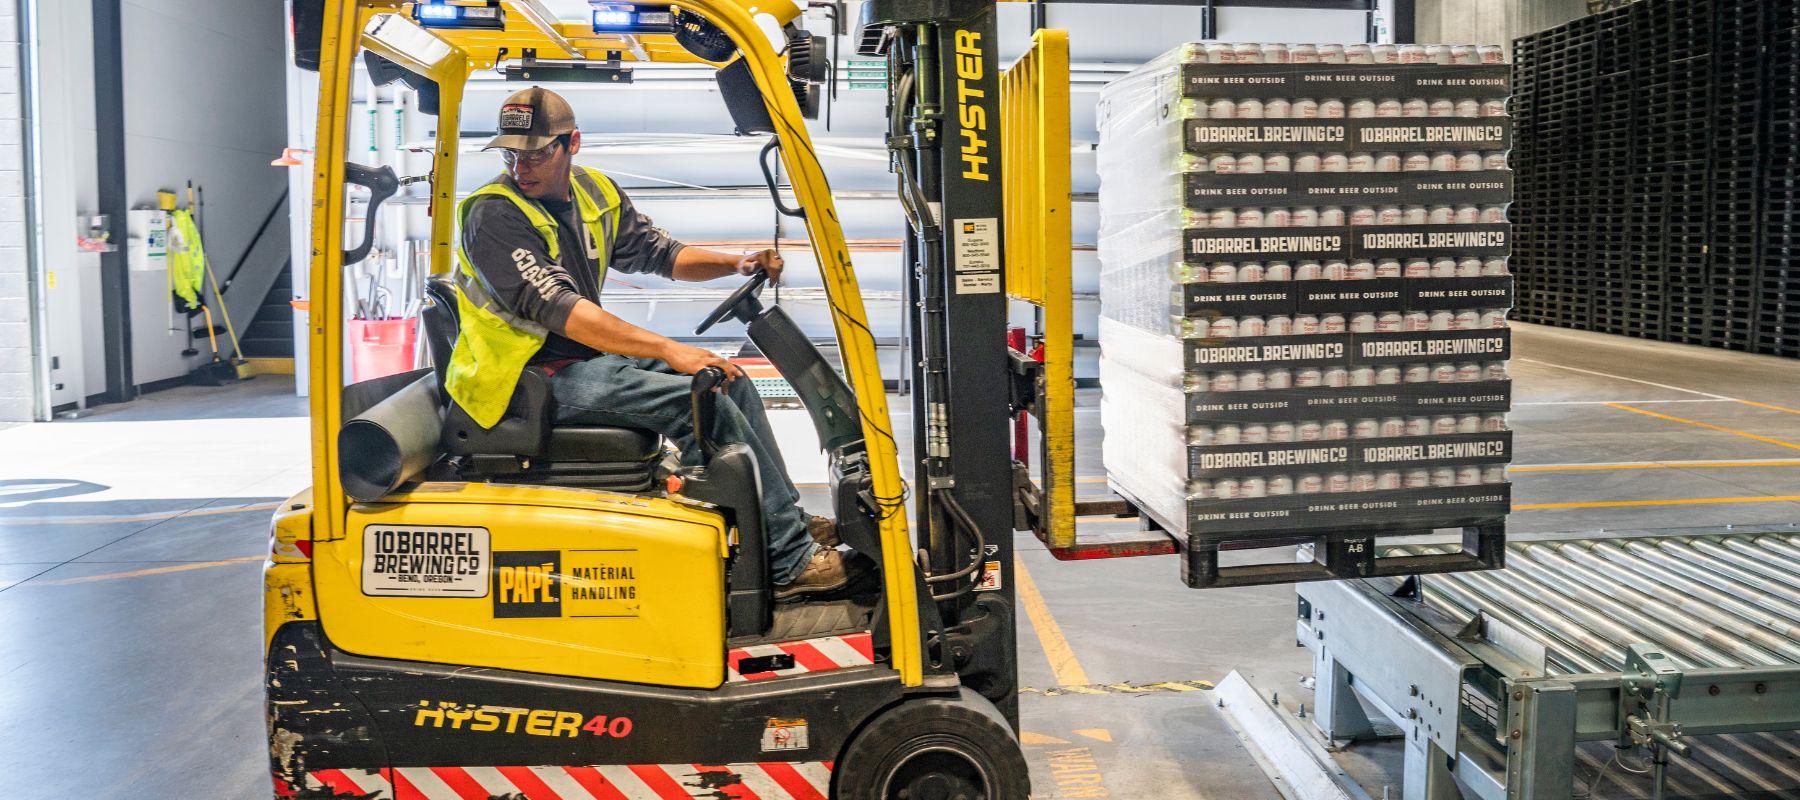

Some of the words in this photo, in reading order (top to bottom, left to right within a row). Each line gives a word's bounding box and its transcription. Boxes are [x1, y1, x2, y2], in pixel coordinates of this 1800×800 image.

[955, 29, 989, 181] HYSTER
[1251, 187, 1287, 195] OUTSIDE
[1363, 186, 1399, 194] OUTSIDE
[1363, 291, 1399, 299] OUTSIDE
[1252, 401, 1289, 409] OUTSIDE
[1469, 494, 1503, 503] OUTSIDE
[1362, 501, 1397, 509] OUTSIDE
[1198, 513, 1226, 521] DRINK
[1253, 510, 1290, 518] OUTSIDE
[1348, 543, 1364, 553] A-B
[374, 554, 454, 574] BREWING
[424, 575, 453, 583] OREGON
[500, 562, 554, 603] PAPÉ
[572, 586, 636, 600] HANDLING
[414, 700, 583, 738] HYSTER
[583, 715, 633, 738] 40
